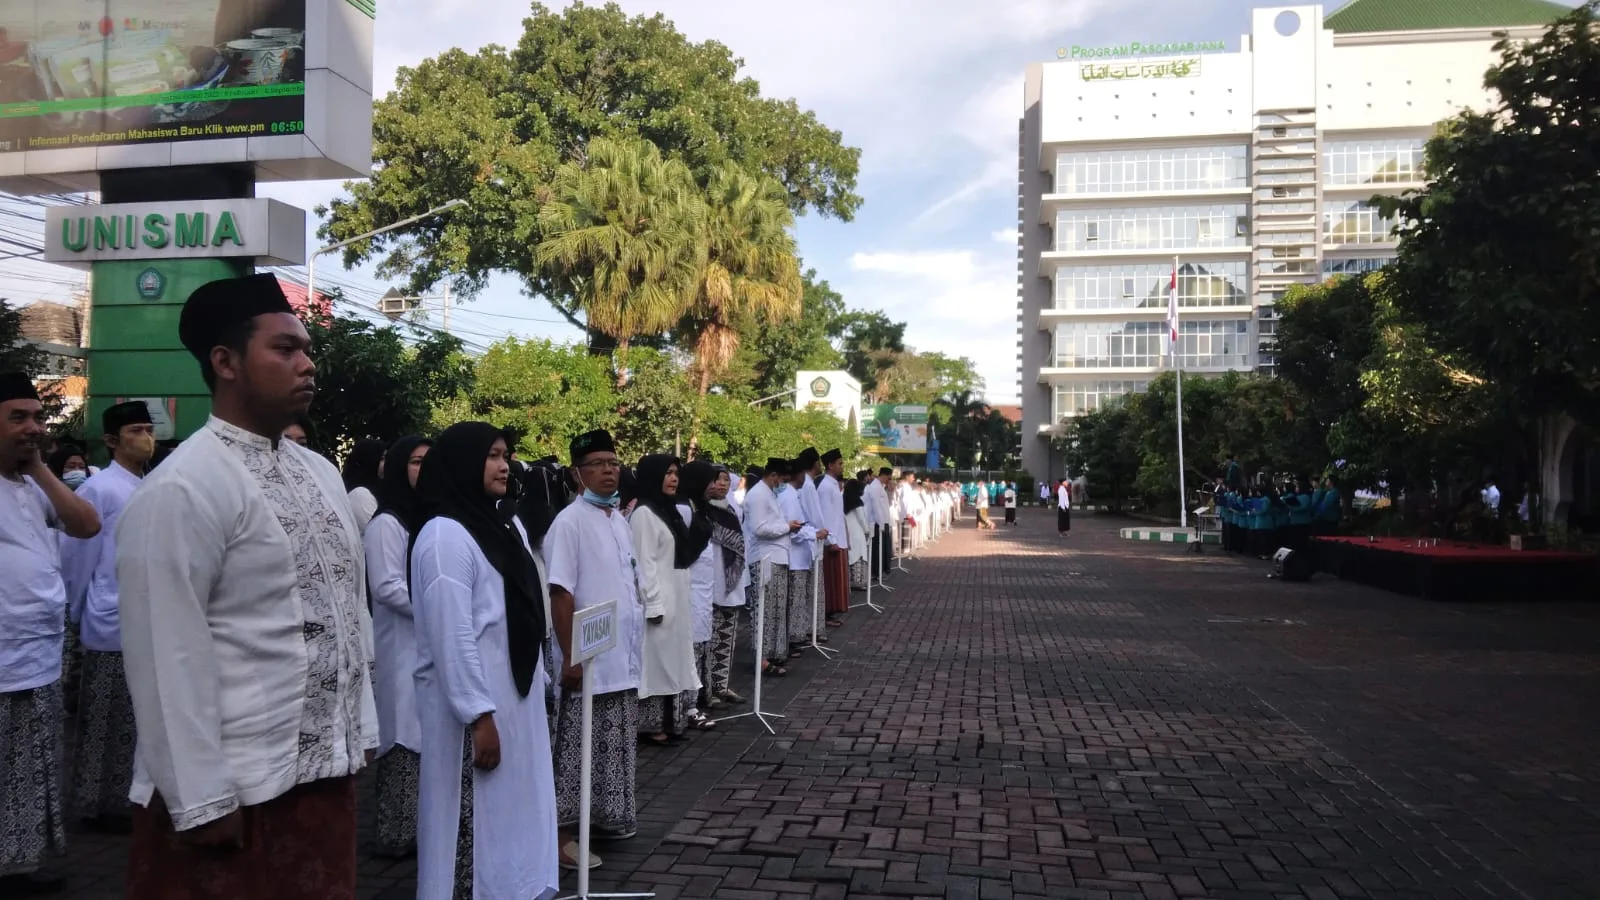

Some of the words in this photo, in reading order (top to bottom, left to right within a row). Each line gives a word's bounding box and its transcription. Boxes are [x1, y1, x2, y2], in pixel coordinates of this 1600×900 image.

[29, 136, 70, 146] Informasi
[71, 131, 126, 144] Pendaftaran
[128, 127, 178, 140] Mahasiswa
[180, 125, 203, 136] Baru
[205, 123, 223, 135] Klik
[225, 122, 265, 134] www.pm
[271, 121, 304, 133] 06:50
[62, 211, 245, 252] UNISMA
[582, 615, 611, 648] YAYASAN
